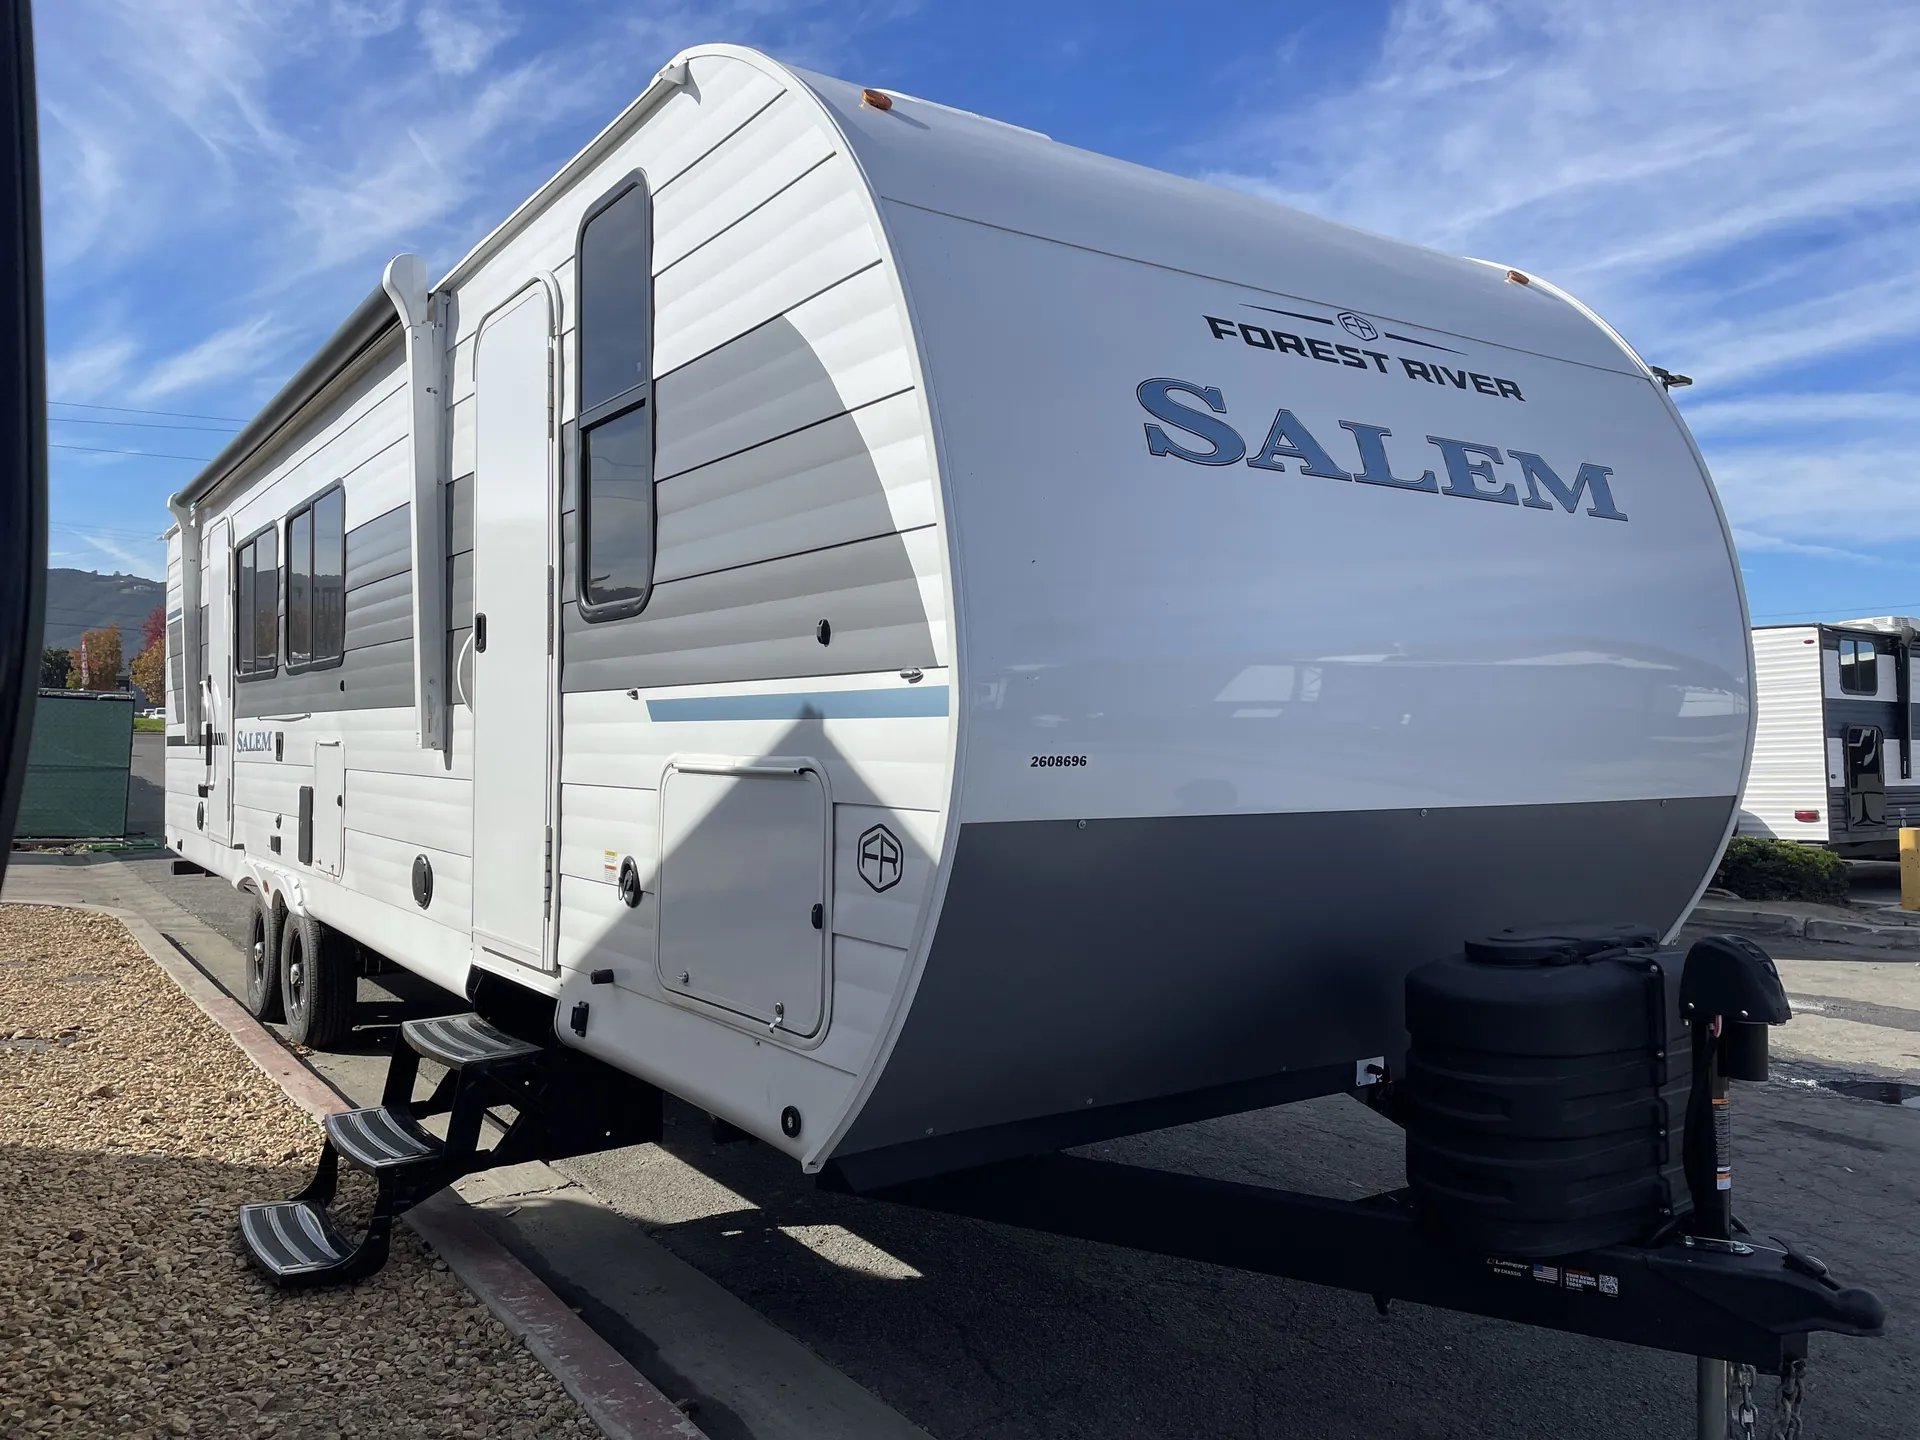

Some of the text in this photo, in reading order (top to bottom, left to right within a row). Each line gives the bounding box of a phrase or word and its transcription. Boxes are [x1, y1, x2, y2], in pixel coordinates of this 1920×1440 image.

[1202, 315, 1526, 402] FOREST RIVER
[1136, 377, 1628, 521] SALEM
[236, 731, 272, 753] SALEM
[1030, 755, 1087, 767] 2608696
